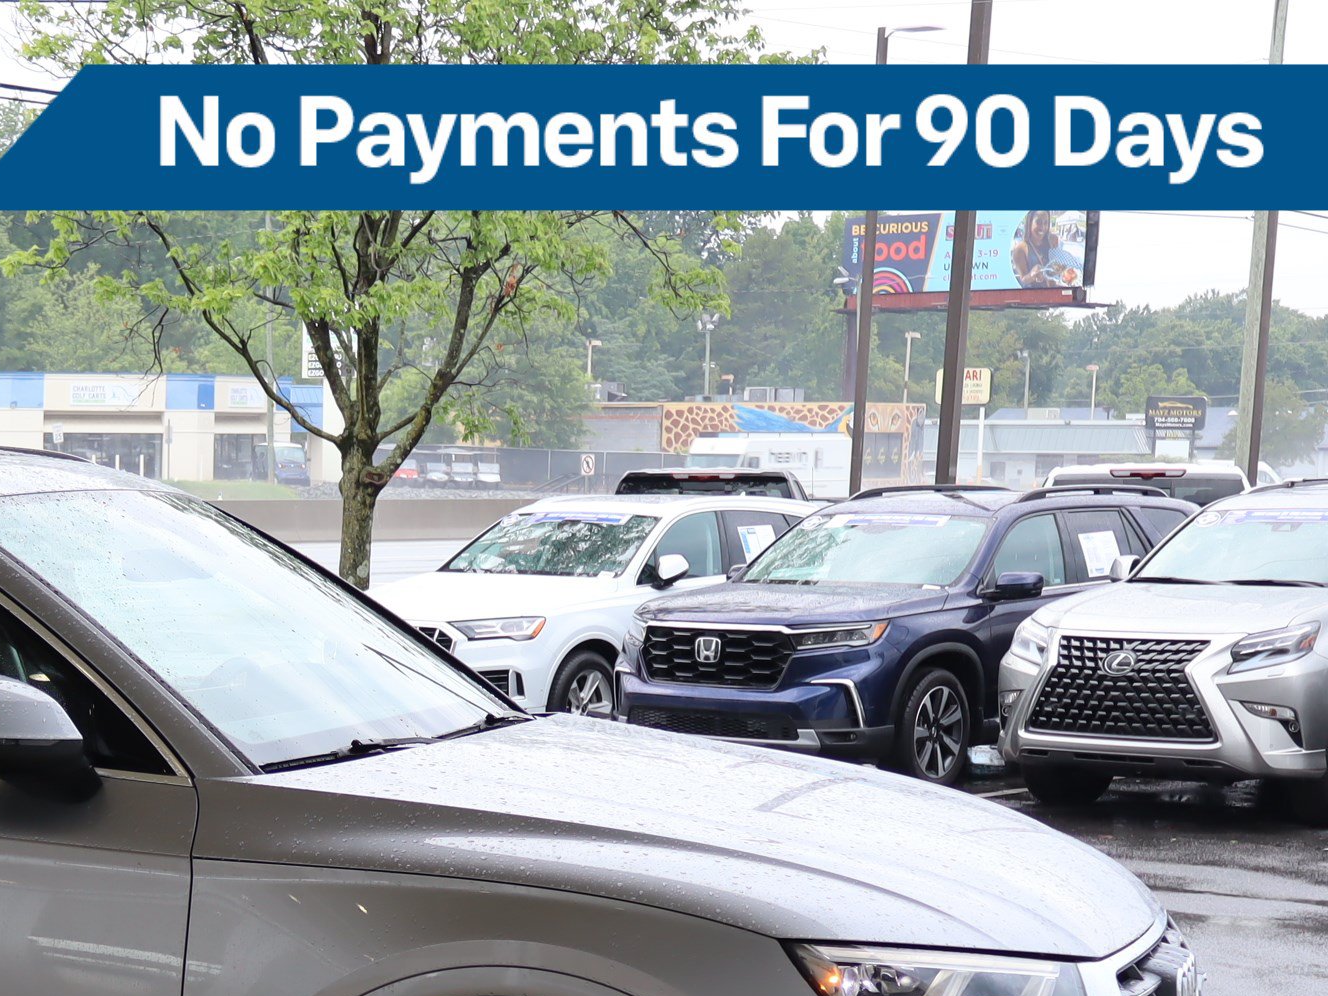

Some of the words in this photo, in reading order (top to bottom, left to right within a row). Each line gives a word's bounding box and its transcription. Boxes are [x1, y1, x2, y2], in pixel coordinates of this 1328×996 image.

[852, 225, 866, 236] BE
[946, 224, 992, 241] SUT
[851, 238, 859, 263] about
[861, 234, 926, 262] ood
[943, 262, 989, 271] UWN
[965, 369, 982, 381] ARI
